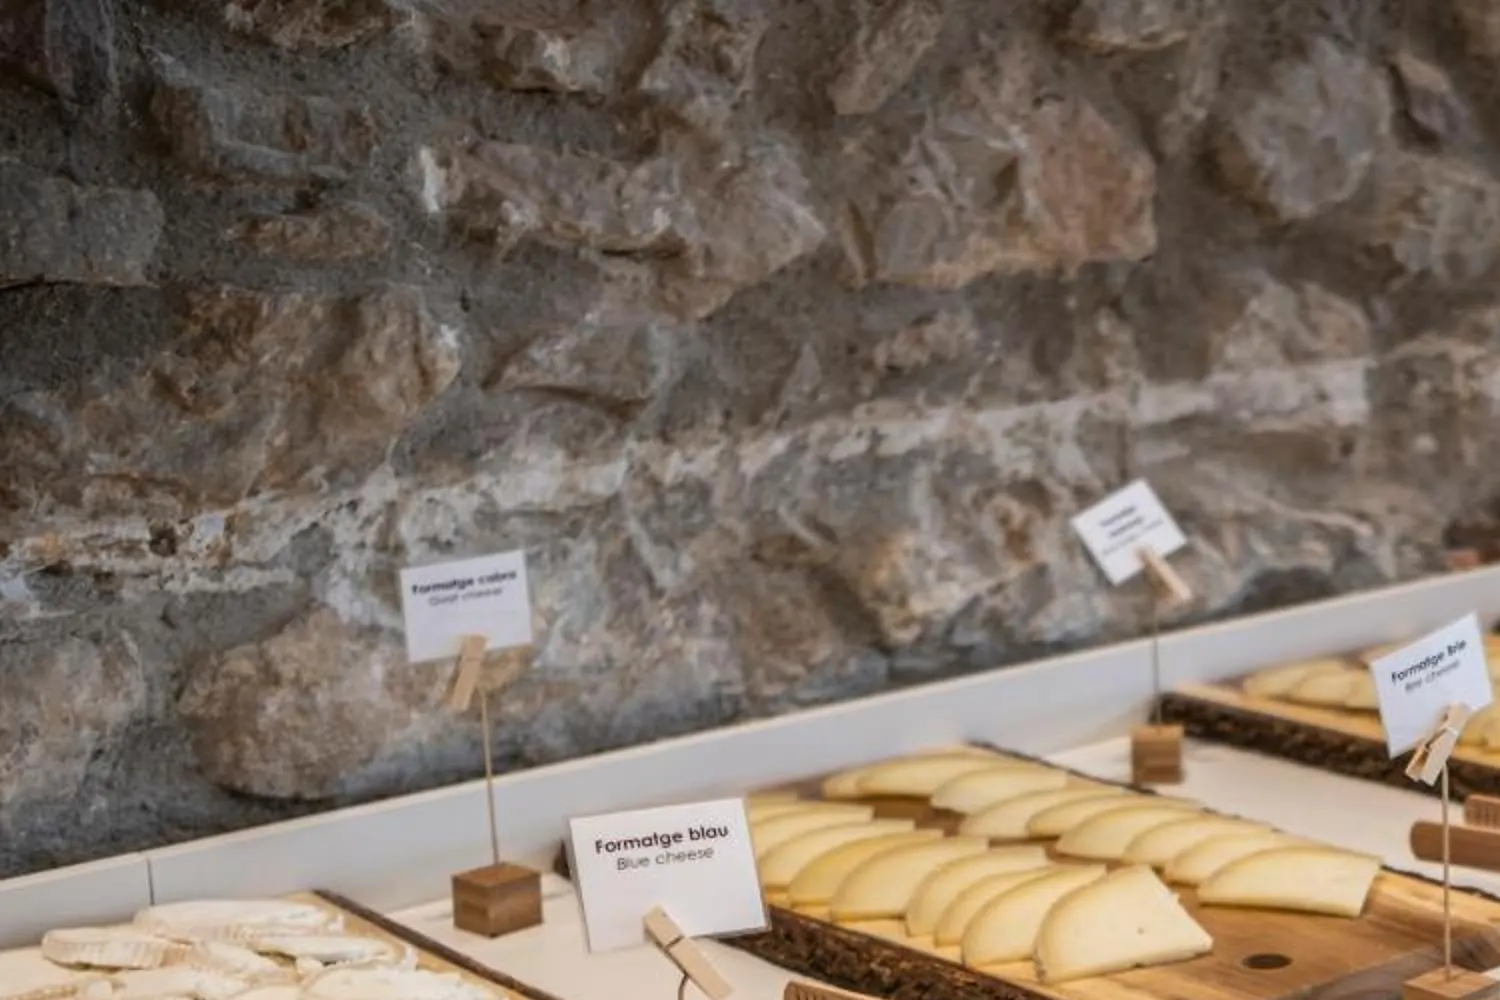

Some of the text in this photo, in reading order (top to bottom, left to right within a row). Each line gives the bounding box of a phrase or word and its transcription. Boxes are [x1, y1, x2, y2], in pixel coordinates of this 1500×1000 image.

[595, 825, 729, 854] Formatge blau
[617, 847, 715, 871] Blue cheese
